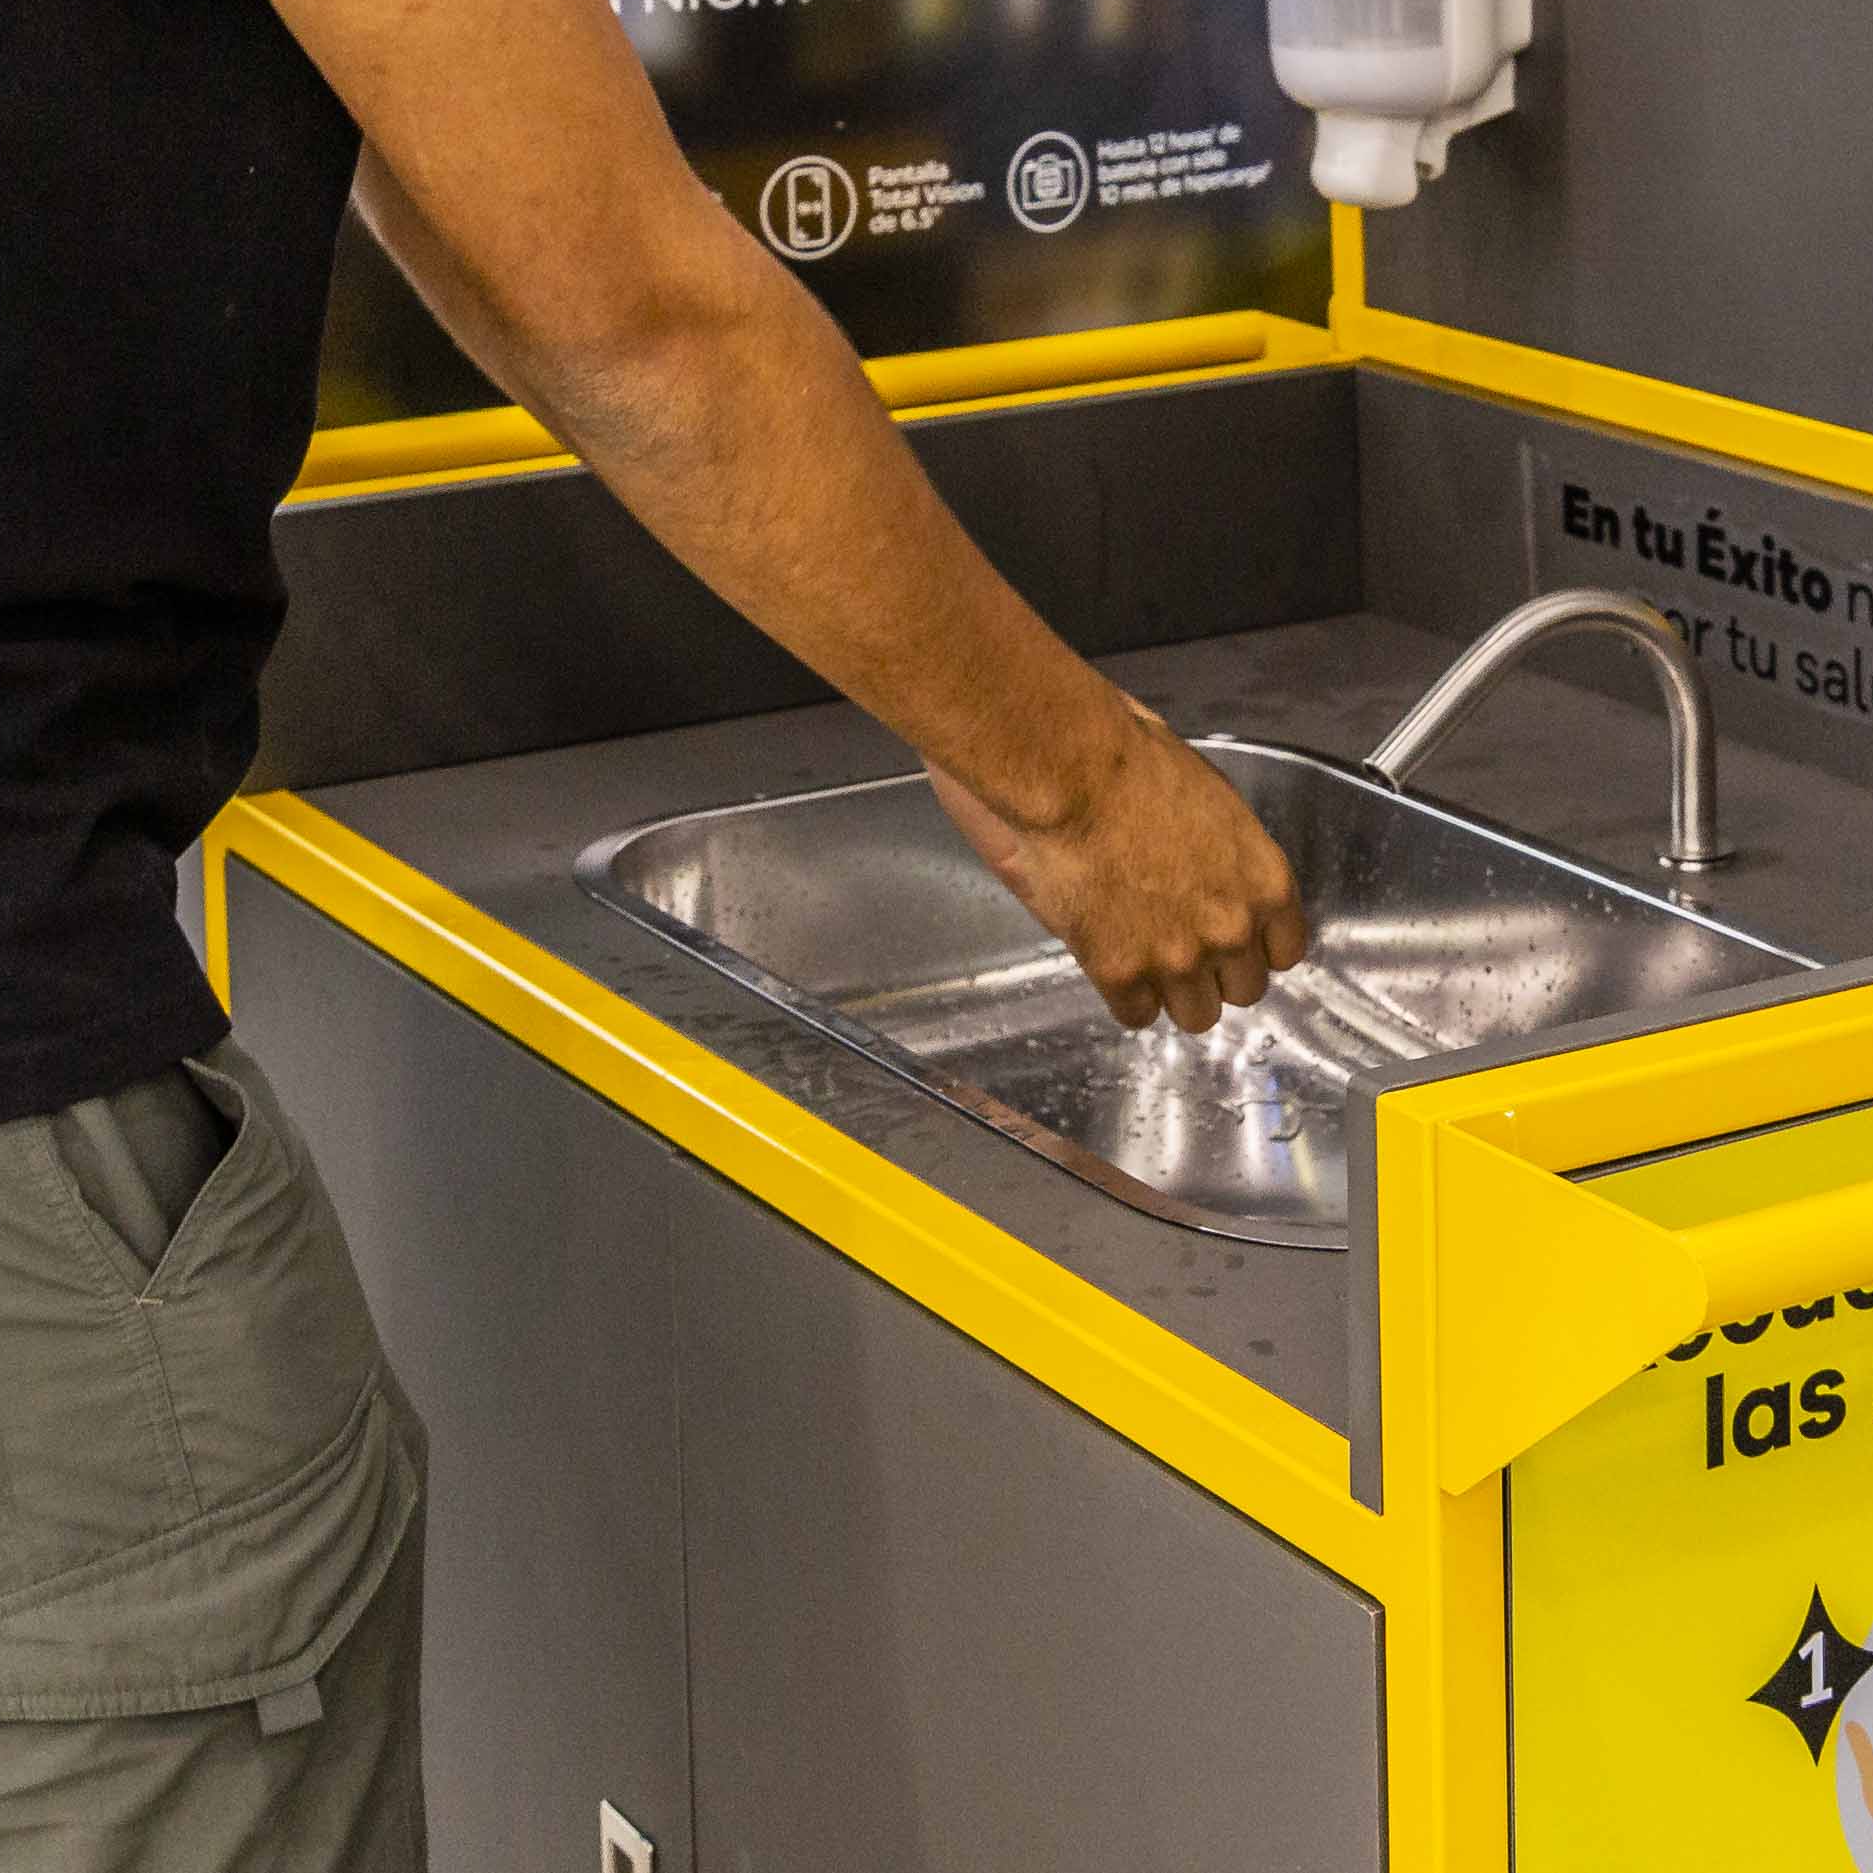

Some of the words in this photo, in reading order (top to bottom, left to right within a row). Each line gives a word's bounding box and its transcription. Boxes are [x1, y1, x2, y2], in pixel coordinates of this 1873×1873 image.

[1561, 483, 1621, 549] En
[1631, 505, 1685, 570] tu
[1695, 507, 1832, 613] Éxito
[1725, 615, 1779, 682] tu
[1704, 1368, 1847, 1469] las
[1797, 1631, 1836, 1710] 1
